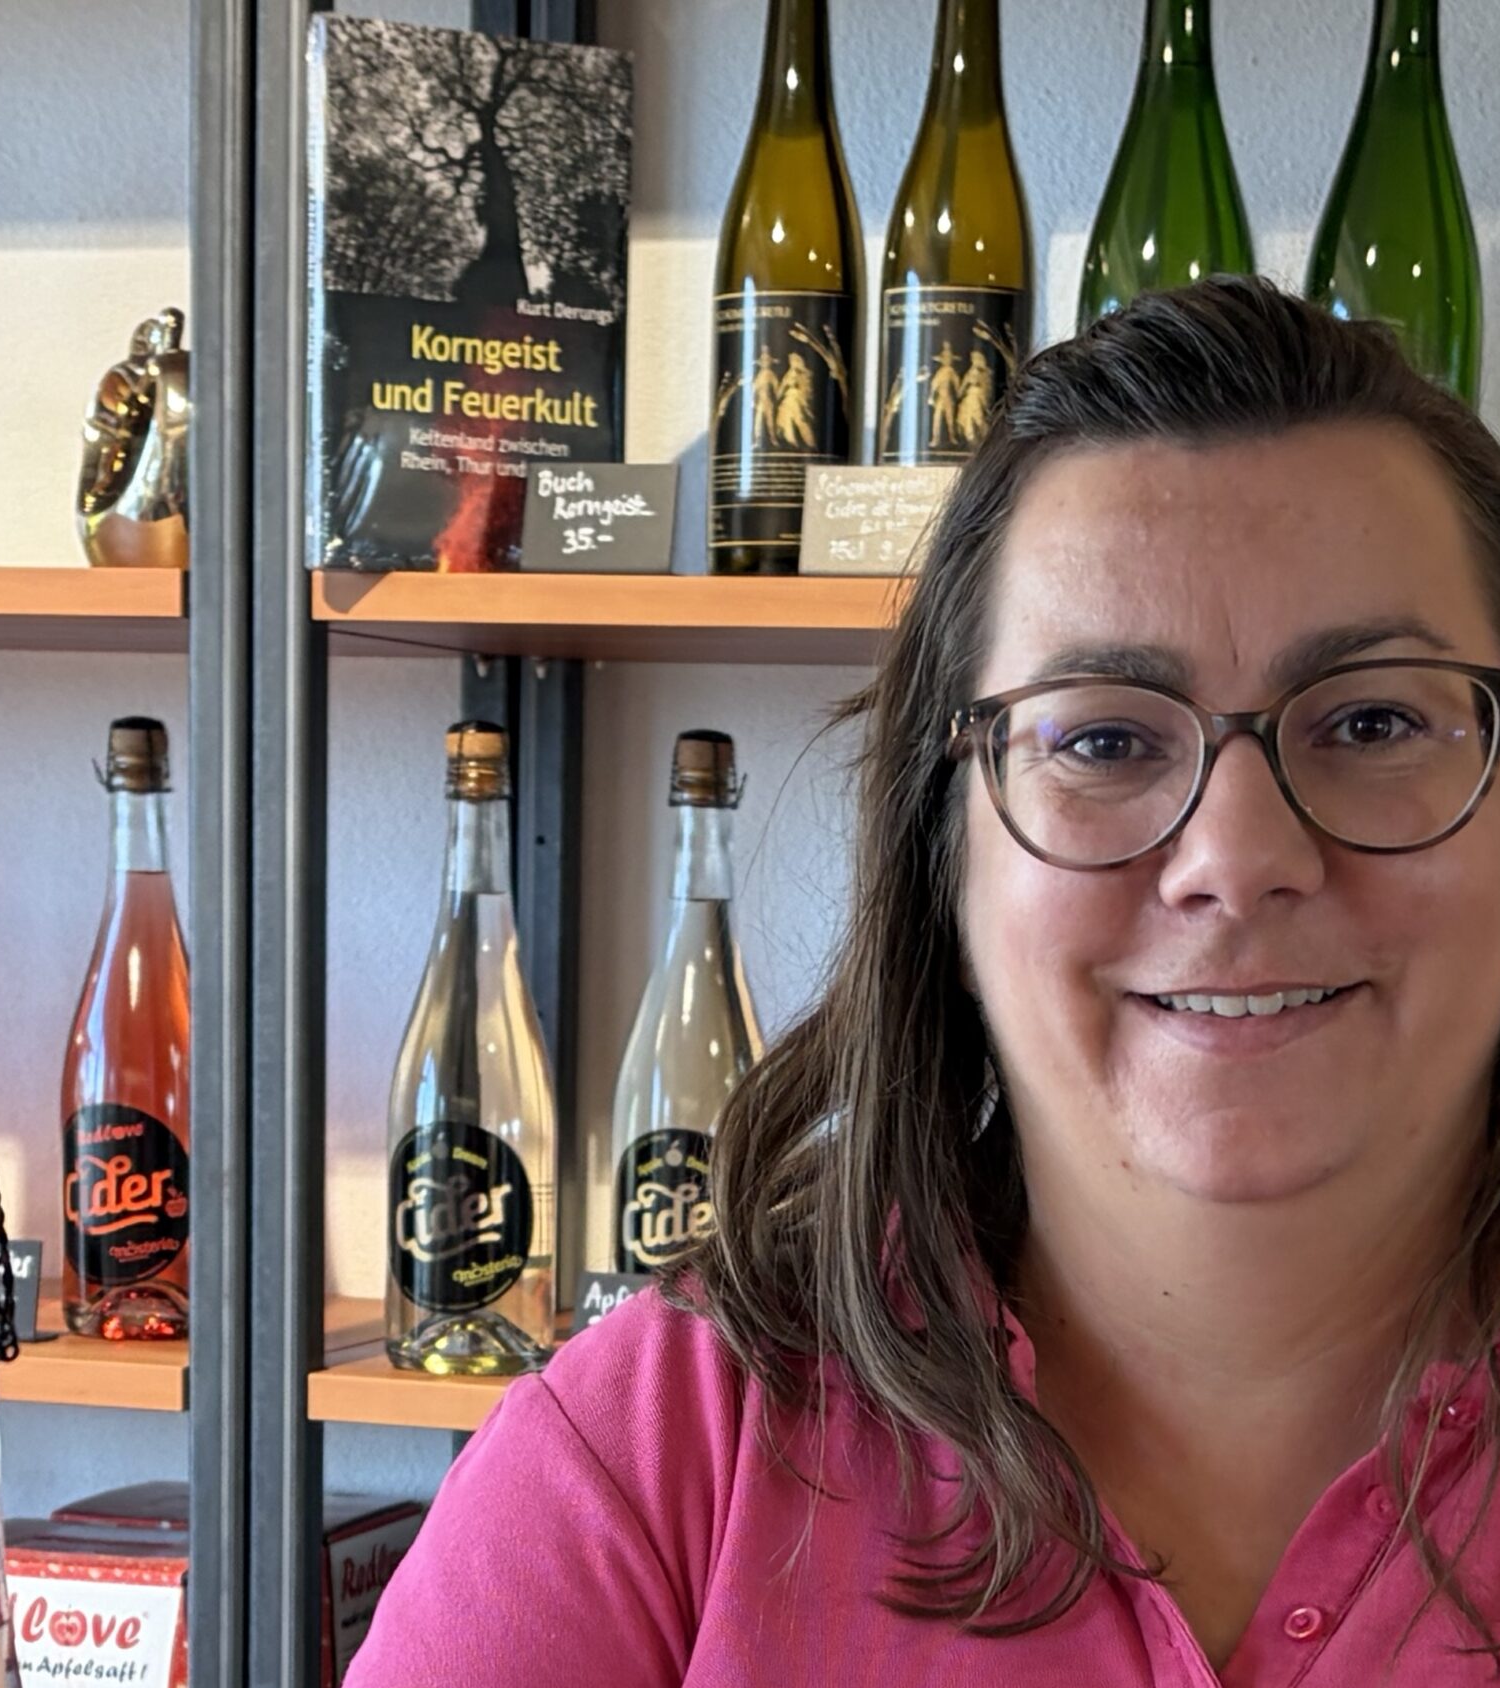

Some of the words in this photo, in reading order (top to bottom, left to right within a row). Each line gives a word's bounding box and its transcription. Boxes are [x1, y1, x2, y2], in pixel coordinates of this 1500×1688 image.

[516, 299, 551, 317] Kurt
[553, 303, 615, 326] Derungs
[411, 324, 563, 375] Korngeist
[372, 378, 433, 413] und
[443, 381, 599, 428] Feuerkult
[408, 428, 495, 453] Keltenland
[498, 437, 570, 459] zwischen
[401, 452, 451, 475] Rhein,
[455, 455, 493, 476] Thur
[497, 461, 528, 478] und
[538, 469, 593, 497] Buch
[553, 494, 655, 525] Korngeist
[396, 1177, 512, 1263] Cider
[622, 1182, 716, 1265] Cide
[12, 1592, 141, 1649] love
